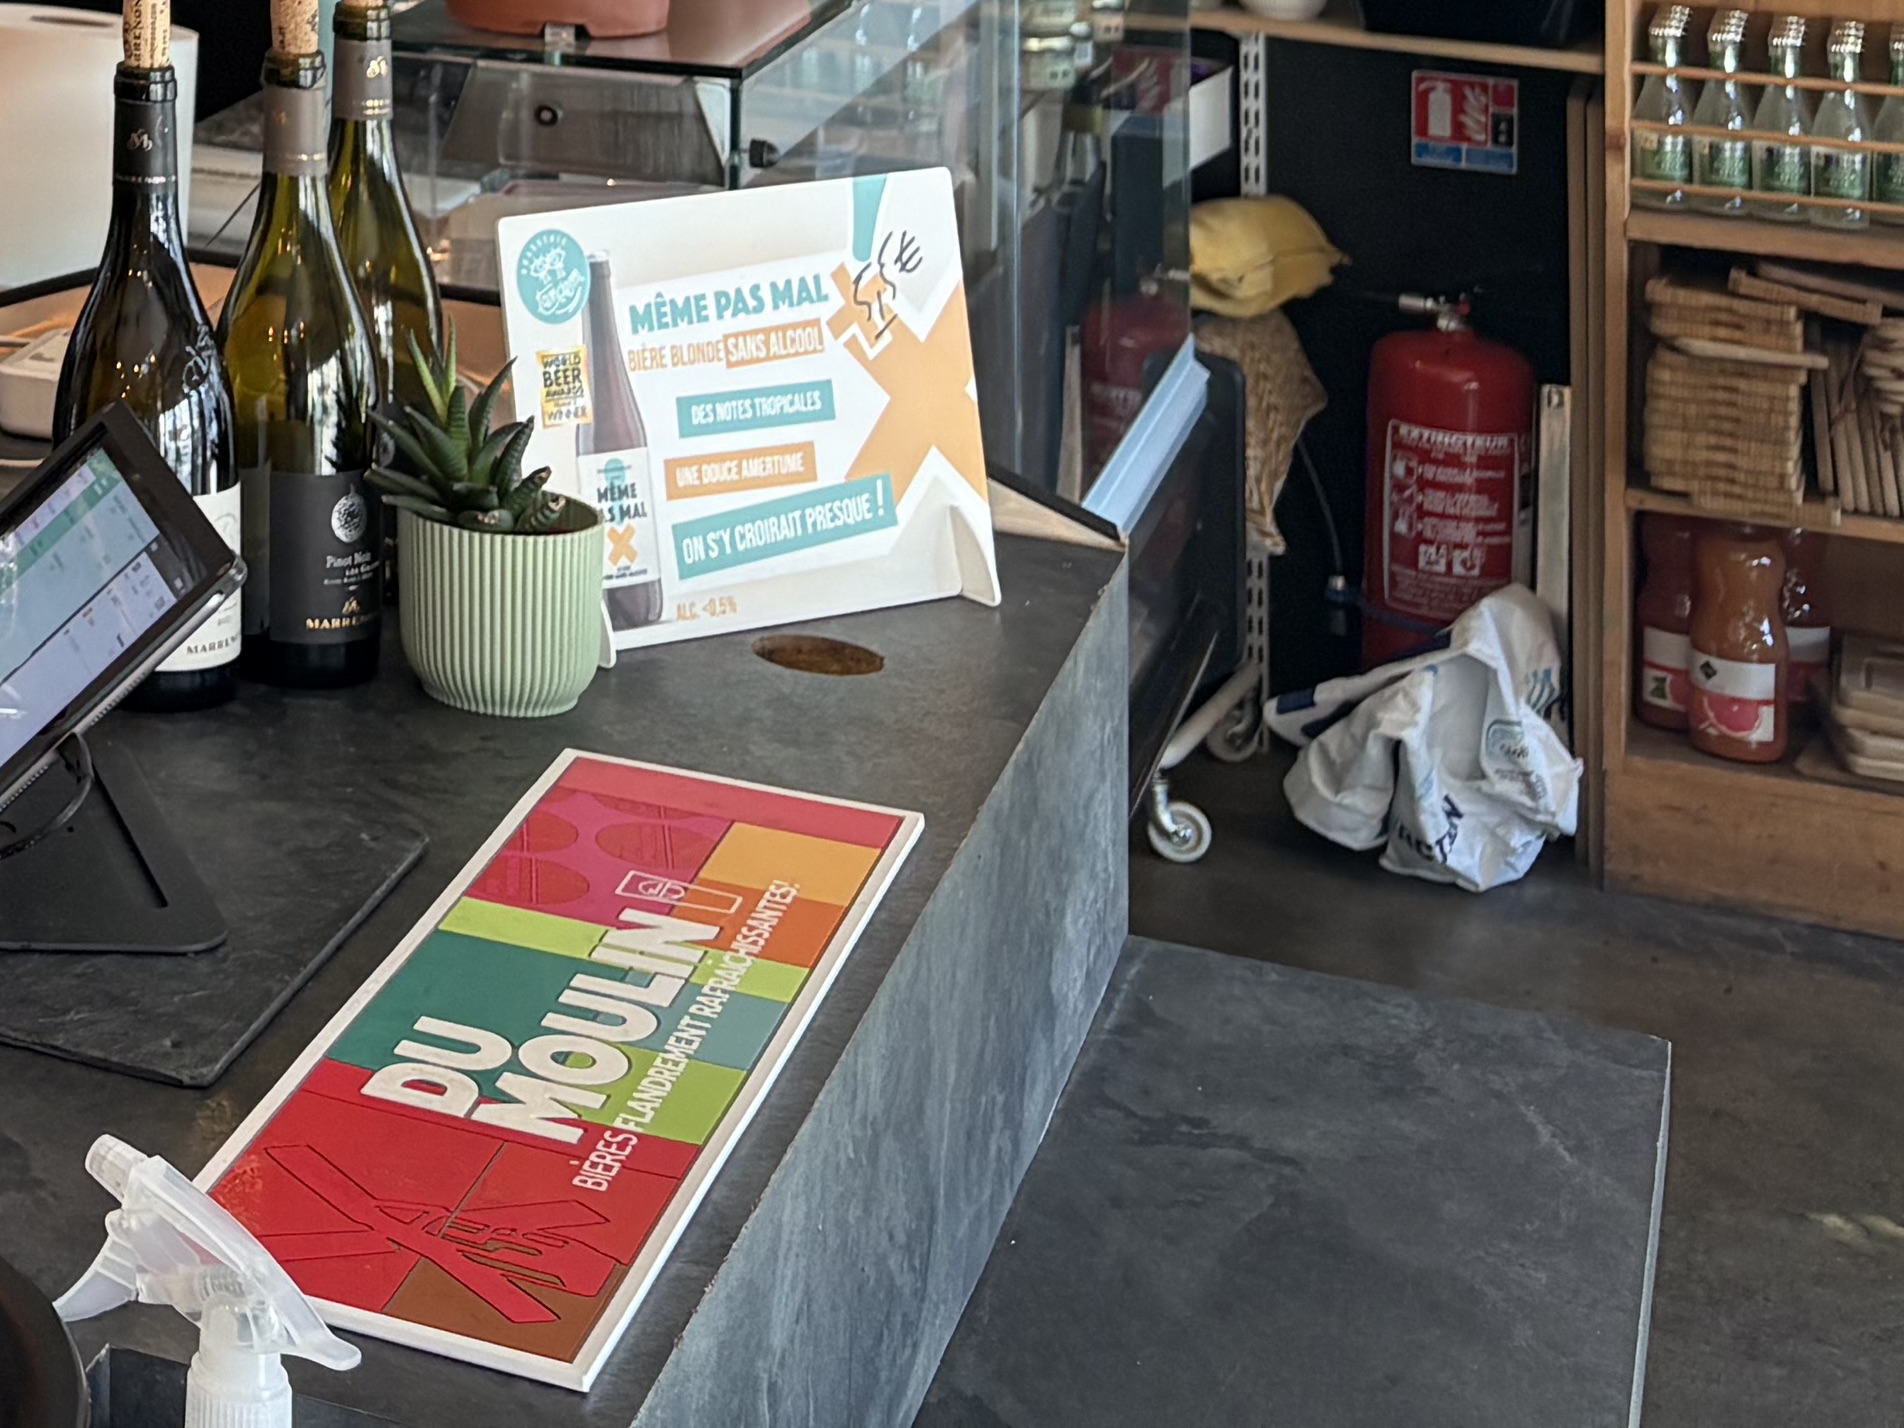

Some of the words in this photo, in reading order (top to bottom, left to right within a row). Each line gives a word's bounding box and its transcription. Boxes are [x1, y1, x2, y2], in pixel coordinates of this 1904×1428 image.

[628, 291, 711, 335] MÊME
[714, 284, 766, 321] PAS
[769, 273, 830, 309] MAL
[627, 342, 669, 373] BIÈRE
[670, 340, 724, 369] BLONDE
[727, 334, 768, 362] SANS
[769, 326, 825, 358] ALCOOL
[542, 366, 583, 389] BEER
[691, 403, 715, 425] DES
[716, 398, 753, 422] NOTES
[754, 390, 822, 417] TROPICALES
[676, 466, 700, 488] UNE
[701, 459, 740, 484] DOUCE
[681, 537, 705, 565] ON
[708, 530, 734, 559] S'Y
[733, 511, 803, 551] CROIRAIT
[805, 492, 873, 530] PRESQUE
[326, 555, 352, 569] Pinot
[471, 908, 720, 1145] MOULIN
[361, 1015, 514, 1117] DU
[569, 1129, 638, 1192] BIÈRES
[612, 1015, 713, 1134] FLANDREMENT
